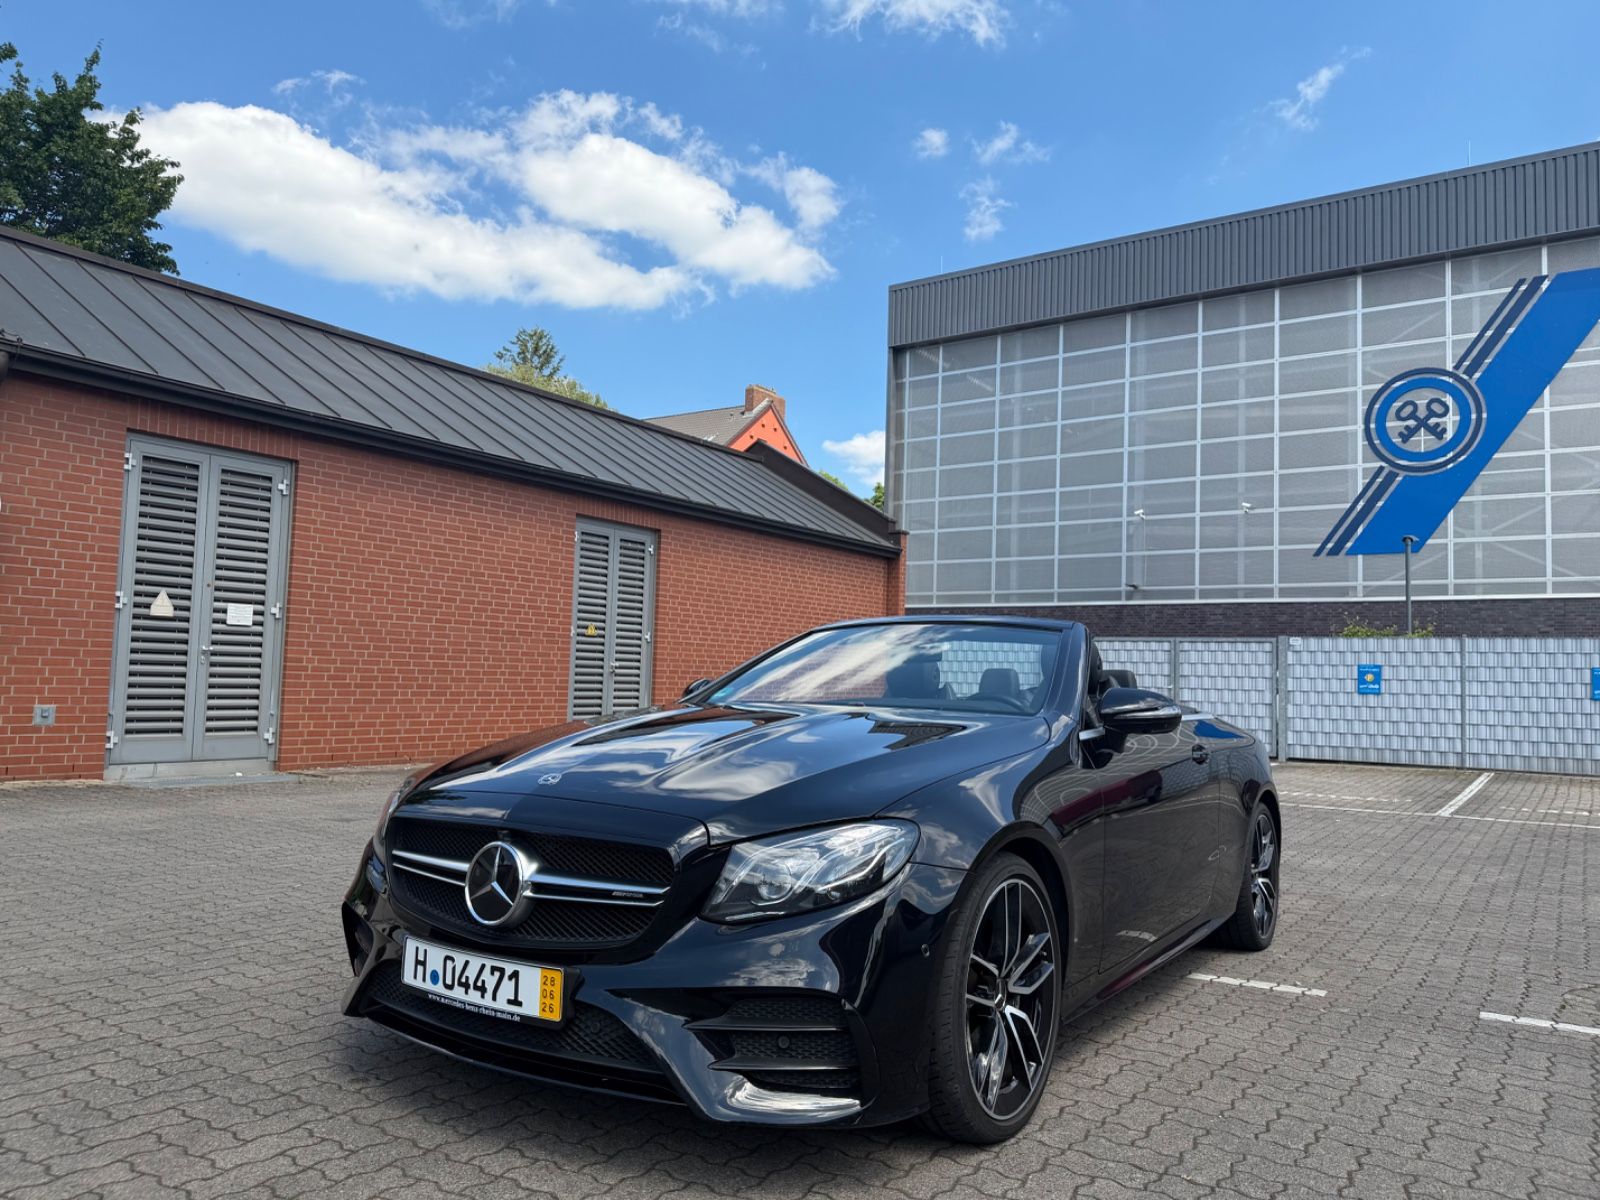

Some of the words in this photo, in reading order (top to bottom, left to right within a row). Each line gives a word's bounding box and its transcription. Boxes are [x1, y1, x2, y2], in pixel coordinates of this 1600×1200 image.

[413, 946, 428, 983] H
[442, 954, 523, 1008] 04471
[542, 975, 556, 987] 28
[541, 989, 555, 1000] 06
[541, 1003, 555, 1014] 26
